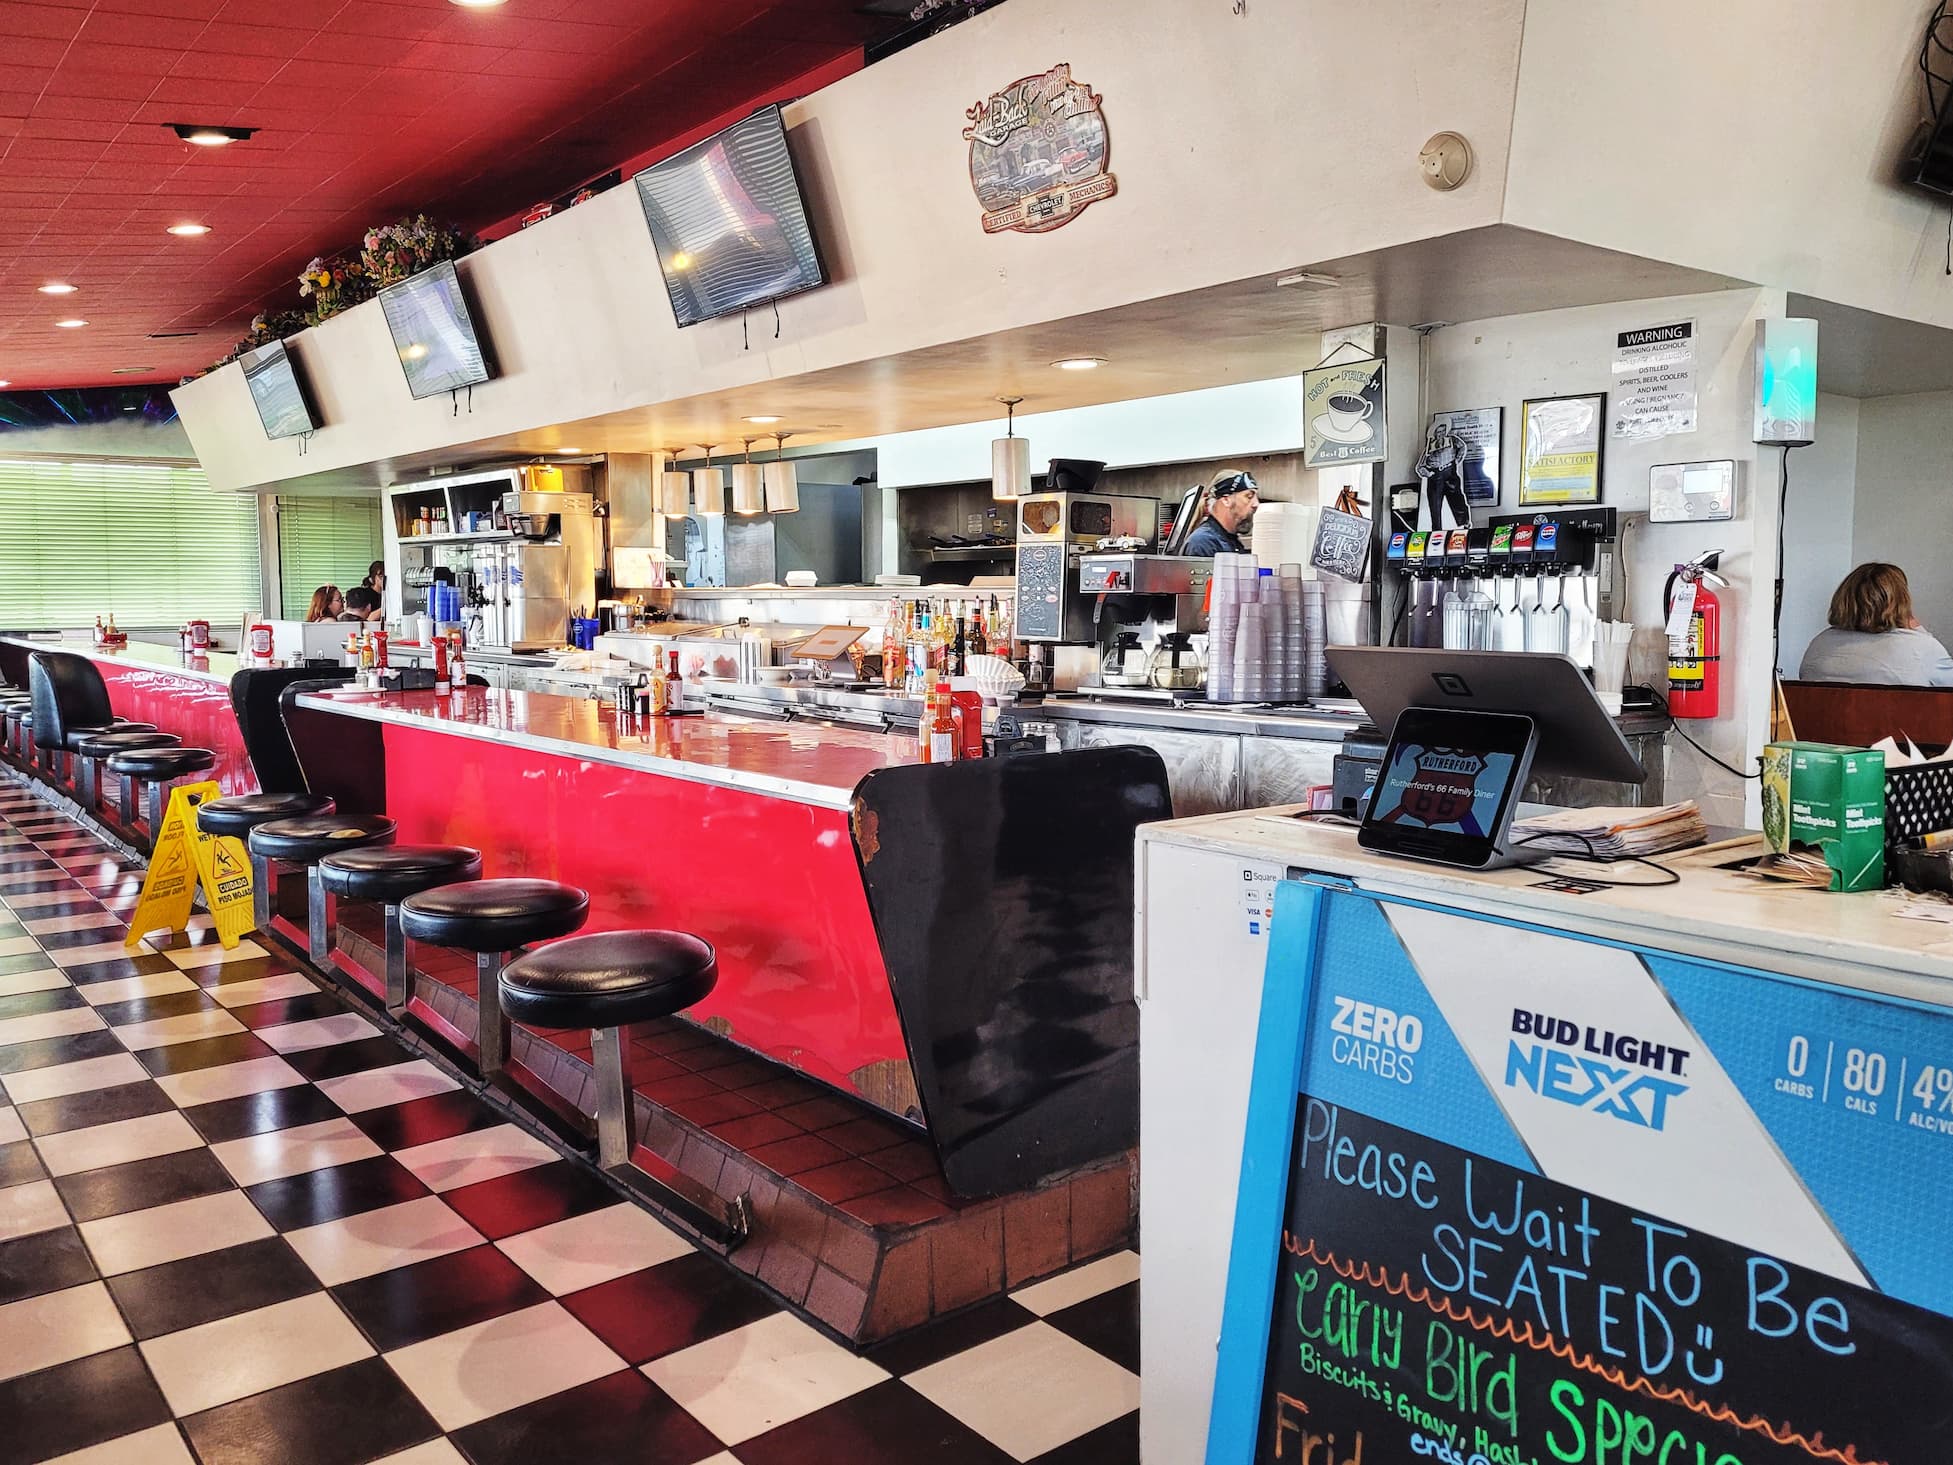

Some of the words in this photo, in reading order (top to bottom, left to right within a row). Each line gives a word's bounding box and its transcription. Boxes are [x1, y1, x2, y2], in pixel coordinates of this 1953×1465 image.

[990, 119, 1028, 137] GARAGE
[1068, 181, 1110, 201] MECHANICS
[1029, 194, 1065, 214] CHEVROLET
[1626, 326, 1683, 345] WARNING
[1621, 345, 1651, 356] DRINKING
[1651, 341, 1688, 352] ALCOHOLIC
[1638, 364, 1669, 374] DISTILLED
[1659, 371, 1689, 381] COOLERS
[1307, 376, 1330, 402] HOT
[1341, 369, 1381, 392] FRESH
[1637, 386, 1651, 394] AND
[1651, 384, 1668, 393] WINE
[1635, 406, 1649, 415] CAN
[1649, 404, 1669, 414] CAUSE
[1320, 449, 1337, 458] Best
[1349, 445, 1376, 455] Coffee
[1528, 454, 1596, 468] SATISFACTORY
[1422, 756, 1477, 773] RUTHERFORD
[1390, 778, 1436, 792] Rutherford's
[1435, 784, 1448, 794] 66
[1447, 785, 1474, 798] Family
[1473, 789, 1496, 800] Diner
[1792, 812, 1837, 828] Toothpicks
[1845, 816, 1883, 829] Toothpicks
[219, 878, 249, 893] CUIDADO
[1253, 872, 1277, 882] Square
[232, 887, 253, 900] MOJAD
[1330, 995, 1424, 1054] ZERO
[1511, 1007, 1580, 1047] BUD
[1584, 1027, 1691, 1077] LIGHT
[1331, 1035, 1415, 1086] CARBS
[1787, 1035, 1809, 1078] 0
[1843, 1048, 1887, 1097] 80
[1774, 1078, 1815, 1099] CARBS
[1844, 1096, 1878, 1116] CALS
[1908, 1112, 1953, 1136] ALC/VO
[1301, 1098, 1440, 1210] Please
[1465, 1158, 1601, 1267] Wait
[1631, 1217, 1702, 1307] To
[1746, 1256, 1857, 1356] Be
[1422, 1223, 1674, 1376] SEATED
[1300, 1342, 1382, 1401] Biscuits
